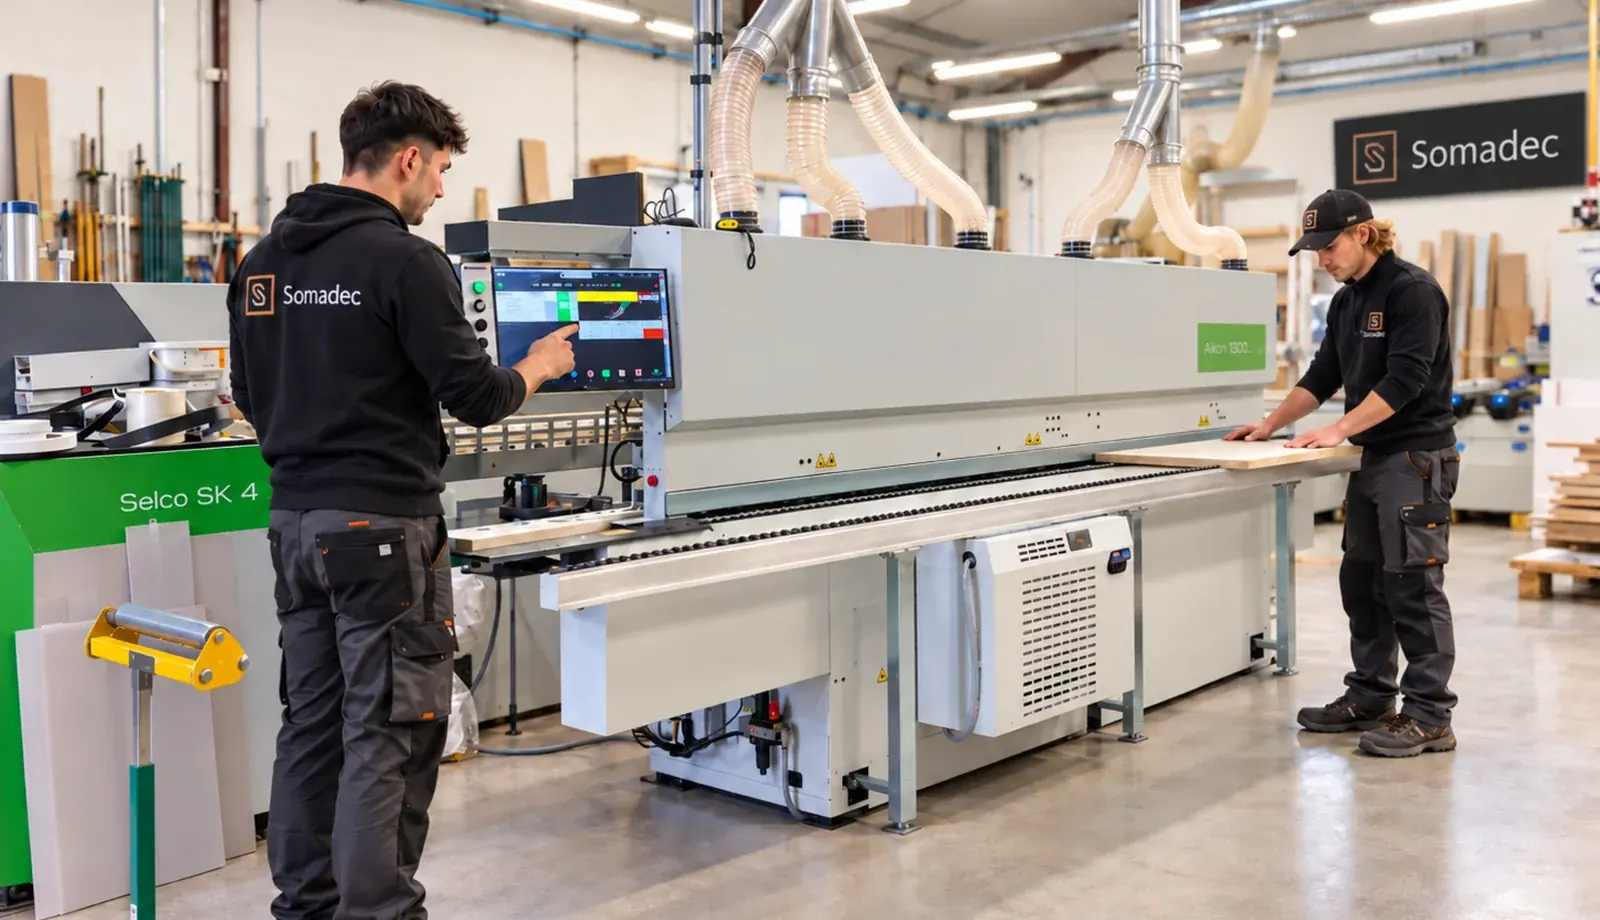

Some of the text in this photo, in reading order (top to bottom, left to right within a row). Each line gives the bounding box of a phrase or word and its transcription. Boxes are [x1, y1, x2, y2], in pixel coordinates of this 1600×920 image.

[1411, 129, 1560, 169] Somadec
[283, 284, 361, 306] Somadec
[120, 482, 258, 512] Selco SK 4
